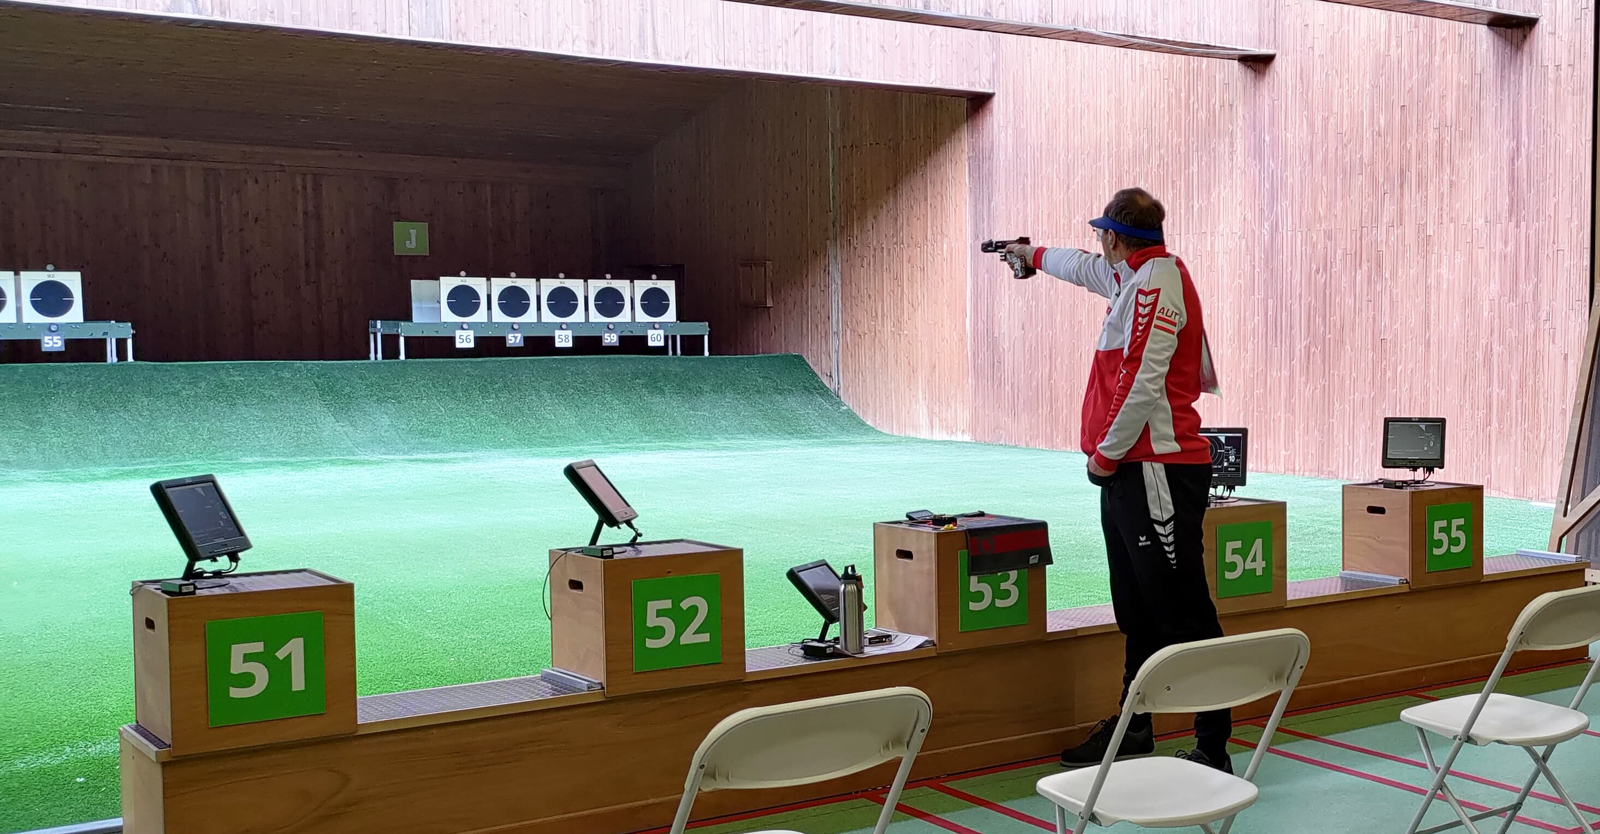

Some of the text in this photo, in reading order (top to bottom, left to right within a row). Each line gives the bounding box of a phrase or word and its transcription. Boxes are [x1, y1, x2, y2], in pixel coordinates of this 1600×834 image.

[405, 229, 417, 248] J
[1157, 306, 1179, 320] AUT
[43, 335, 62, 347] 55
[458, 334, 472, 344] 56
[508, 333, 522, 344] 57
[557, 334, 570, 343] 58
[604, 333, 617, 343] 59
[650, 333, 662, 342] 60
[1432, 517, 1466, 556] 55
[1224, 538, 1266, 580] 54
[968, 569, 1020, 611] 53
[645, 595, 710, 649] 52
[229, 637, 306, 698] 51
